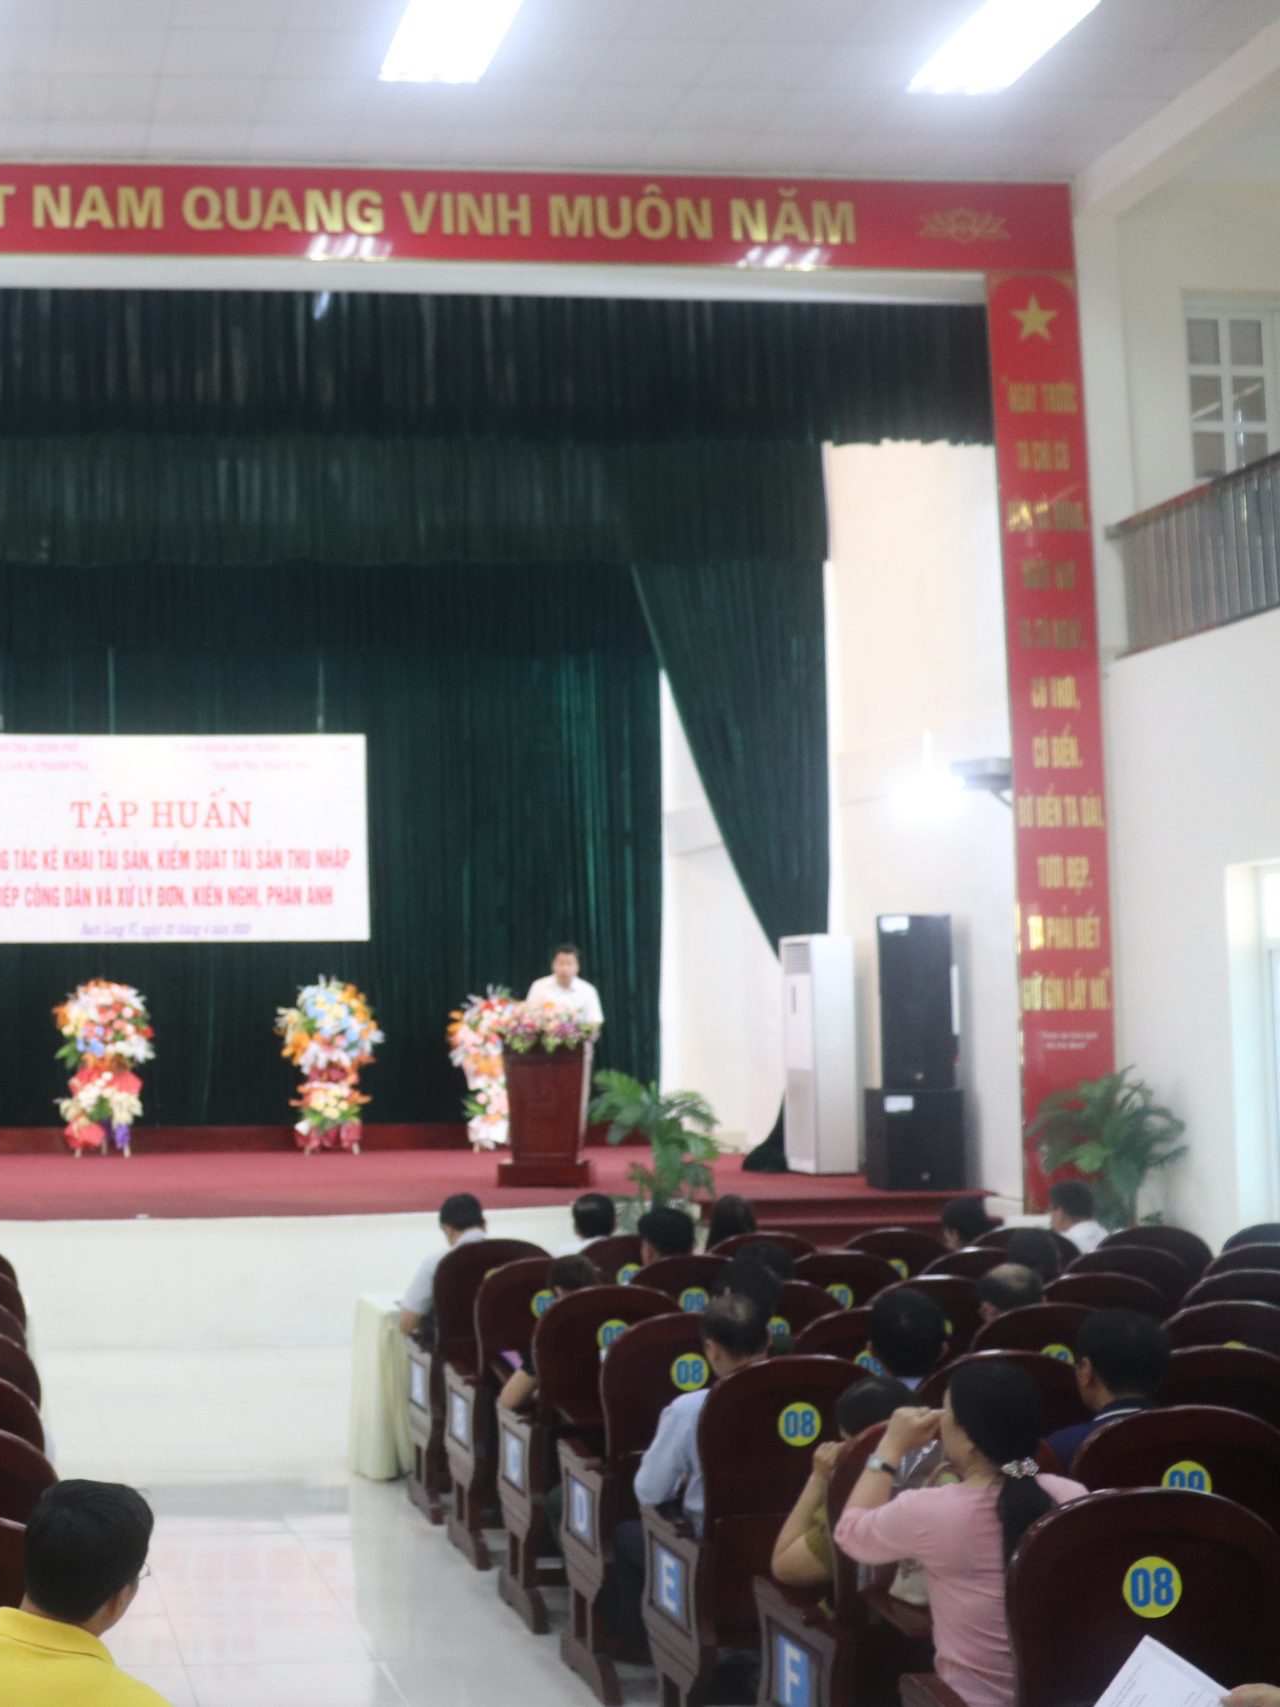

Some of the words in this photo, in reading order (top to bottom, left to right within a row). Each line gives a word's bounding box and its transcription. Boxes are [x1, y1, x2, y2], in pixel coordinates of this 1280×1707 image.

[32, 186, 164, 230] NAM
[182, 186, 385, 235] QUANG
[401, 191, 532, 237] VINH
[549, 185, 713, 241] MUÔN
[730, 189, 857, 244] NĂM
[70, 792, 139, 836] TẬP
[150, 788, 252, 829] HUẤN
[63, 849, 93, 871] KHAI
[287, 849, 311, 871] THU
[24, 883, 60, 908] CÔNG
[677, 1361, 704, 1385] 08
[784, 1410, 815, 1438] 08
[659, 1550, 678, 1614] E
[1131, 1567, 1173, 1607] 08
[781, 1636, 801, 1706] F
